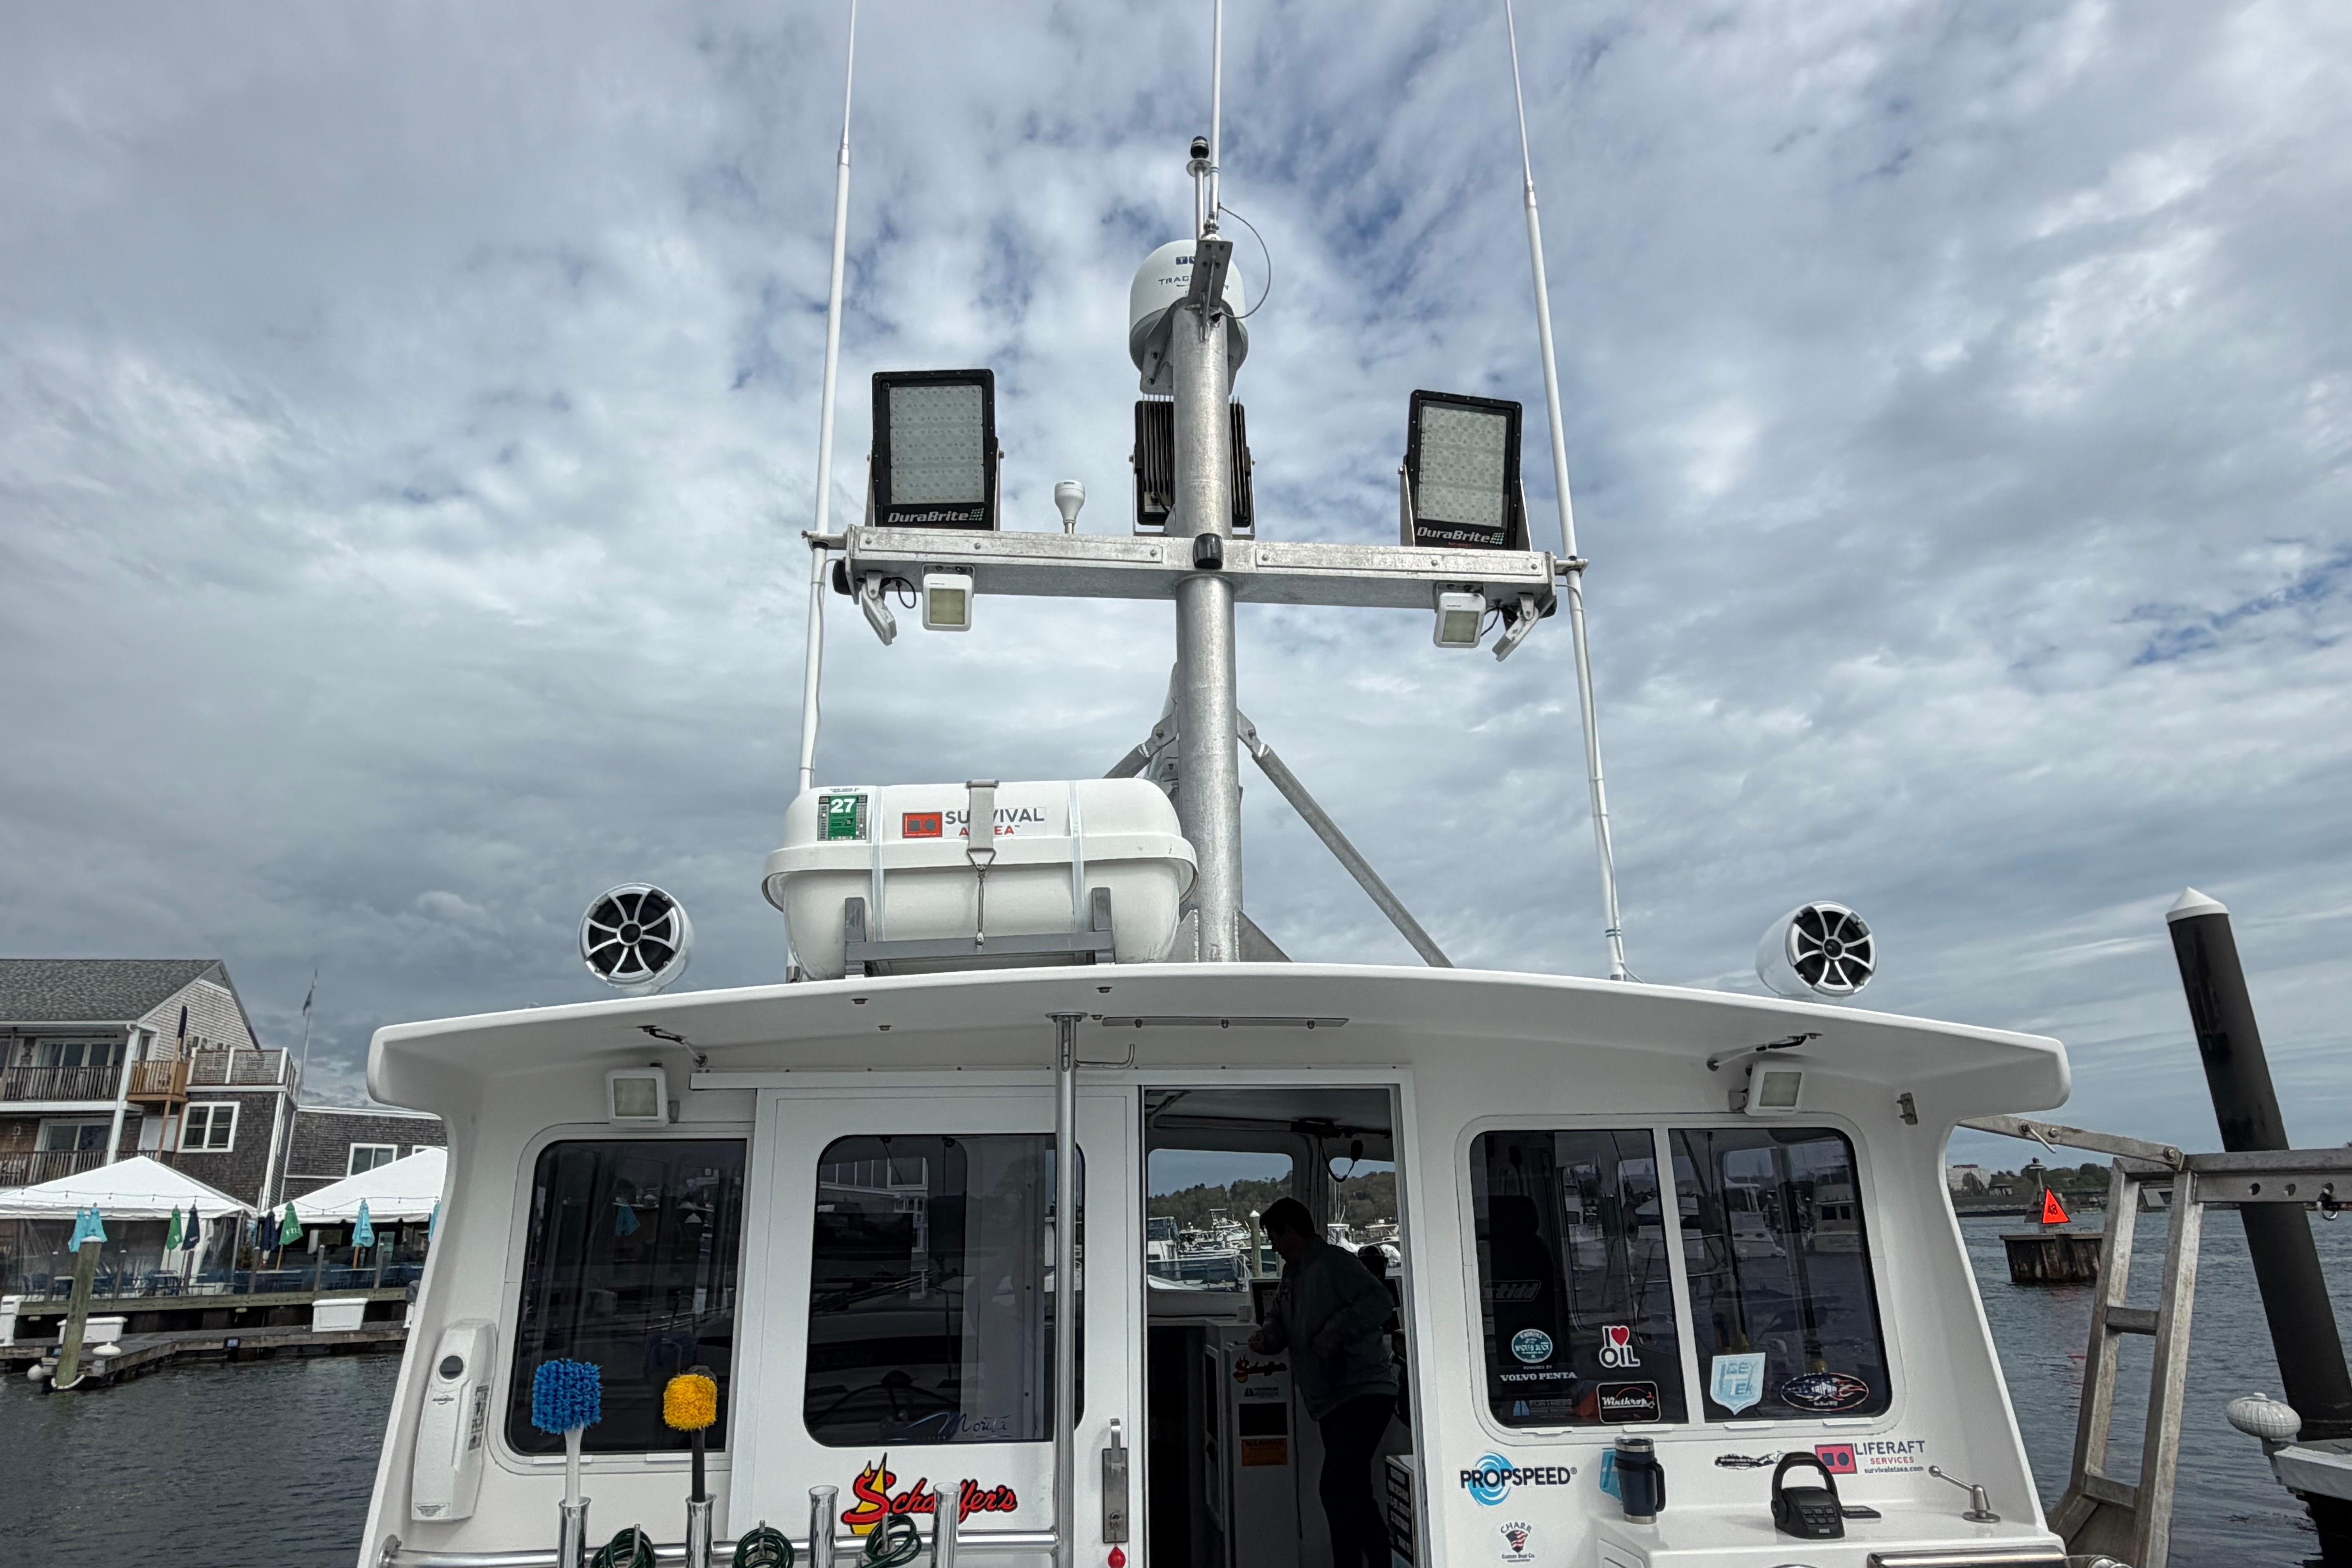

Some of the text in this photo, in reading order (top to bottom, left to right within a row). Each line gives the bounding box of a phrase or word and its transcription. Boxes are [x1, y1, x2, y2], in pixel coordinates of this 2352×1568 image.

[888, 511, 968, 523] DuraBrite
[1417, 526, 1490, 543] DuraBrite
[830, 798, 856, 813] 27
[1601, 1347, 1640, 1366] OIL
[1538, 1372, 1578, 1380] PENTA
[1601, 1397, 1647, 1407] Winthrop
[1854, 1440, 1925, 1455] LIFERAFT
[1500, 1522, 1532, 1534] CHARR
